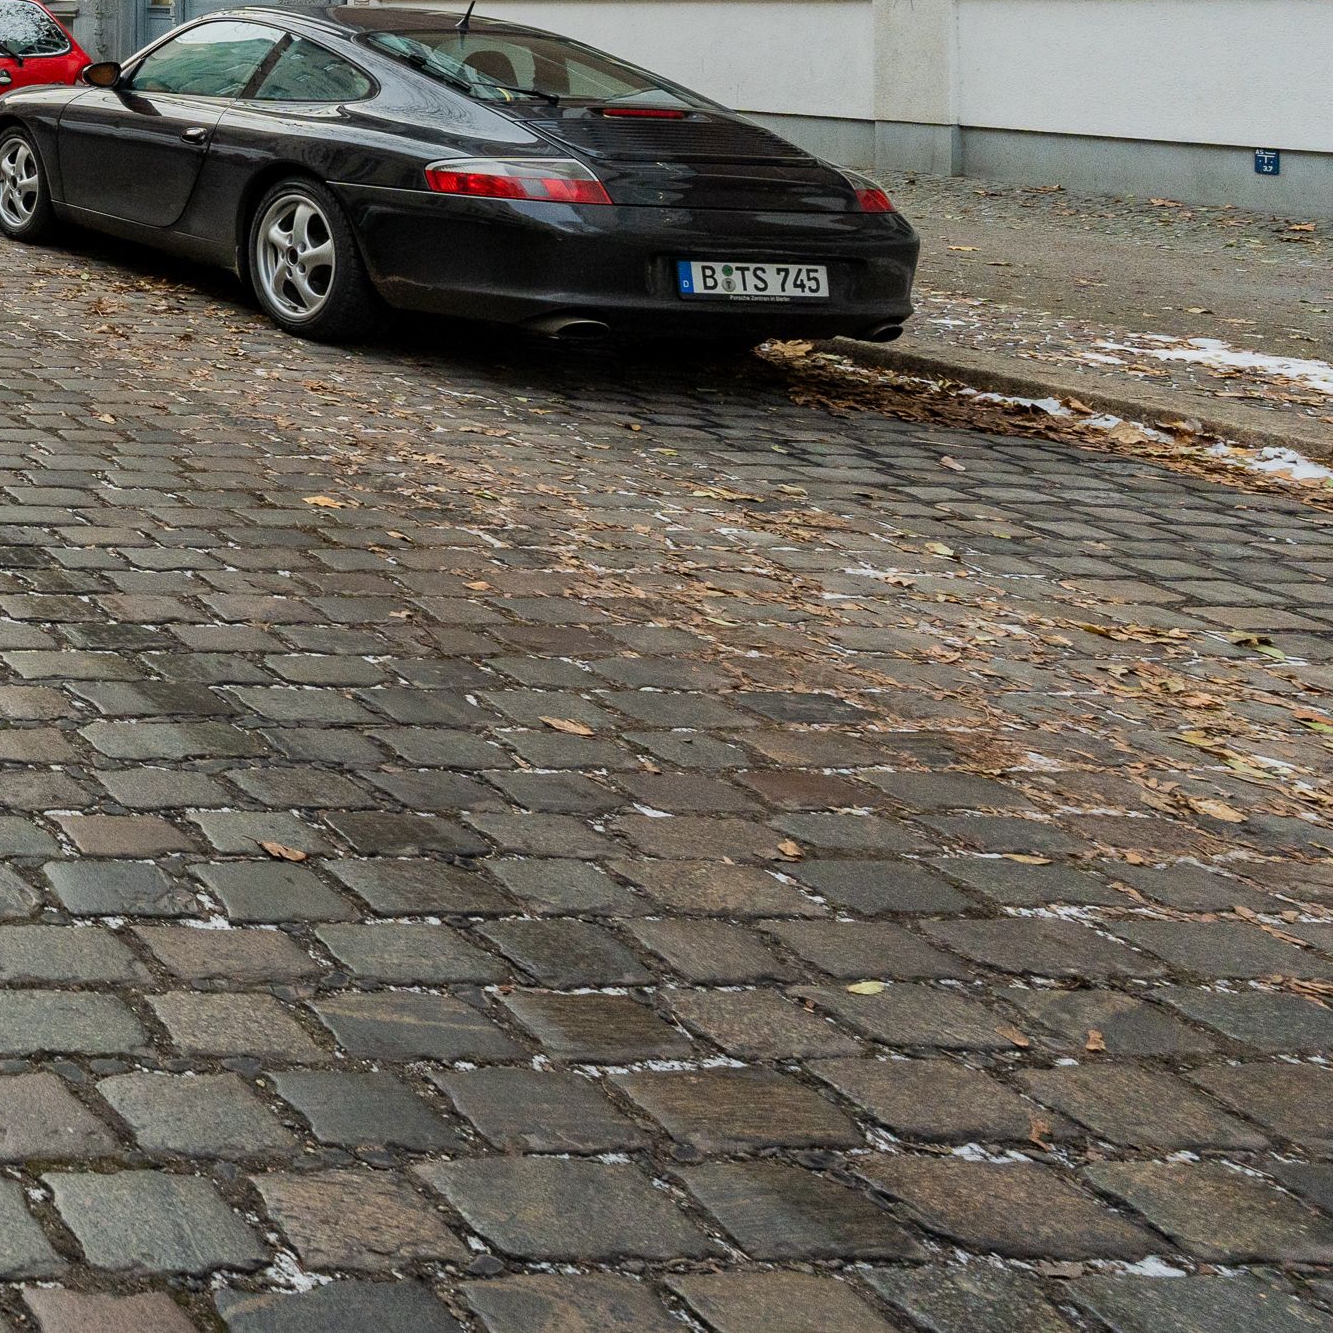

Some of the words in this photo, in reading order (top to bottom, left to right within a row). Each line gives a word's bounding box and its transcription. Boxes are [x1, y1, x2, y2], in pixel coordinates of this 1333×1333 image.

[701, 265, 718, 290] B
[735, 266, 768, 292] TS
[776, 267, 820, 293] 745
